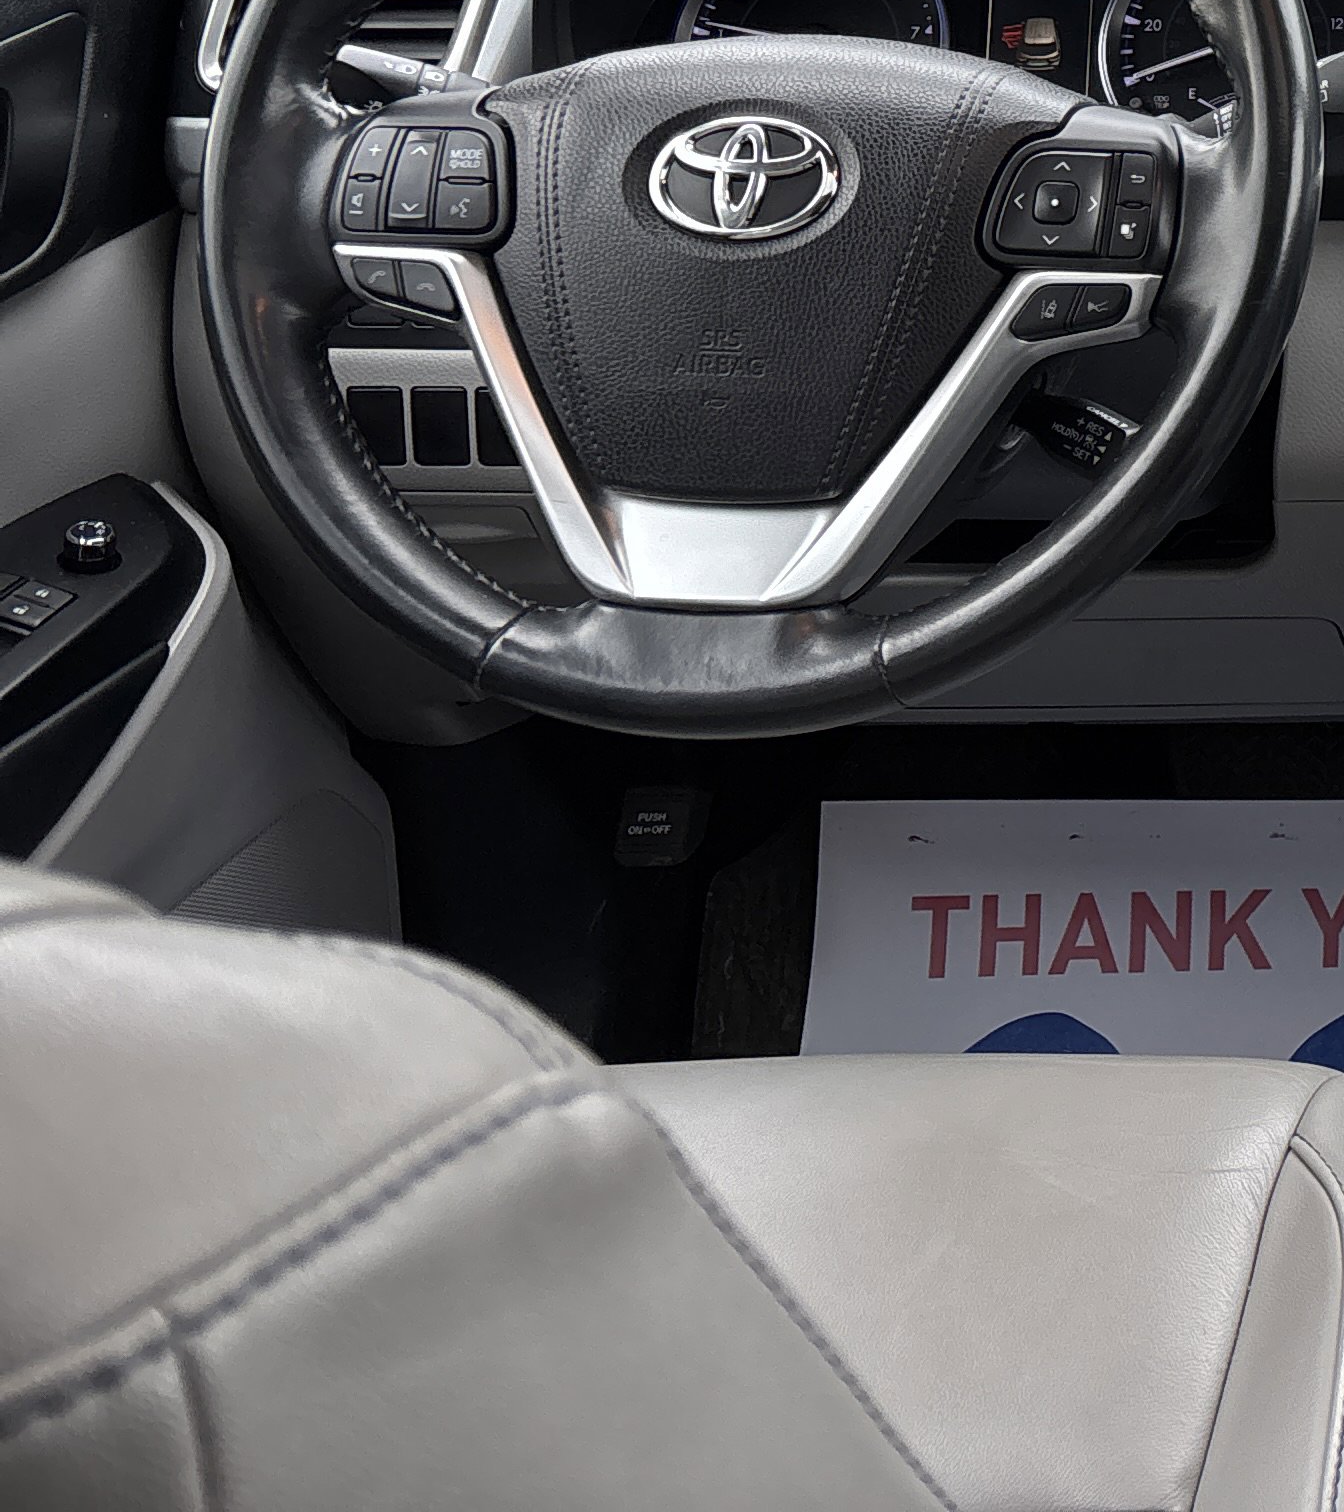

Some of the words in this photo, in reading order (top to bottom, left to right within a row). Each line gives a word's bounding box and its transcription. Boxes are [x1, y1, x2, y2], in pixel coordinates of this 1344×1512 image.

[910, 25, 921, 40] 7
[1144, 18, 1163, 33] 20
[1188, 88, 1197, 100] E
[450, 148, 484, 160] MODE
[699, 329, 743, 349] SRS
[673, 352, 766, 378] AIRBAG
[1085, 421, 1105, 437] RES
[1072, 447, 1091, 462] SET
[637, 812, 667, 822] PUSH
[911, 889, 1273, 979] THANK
